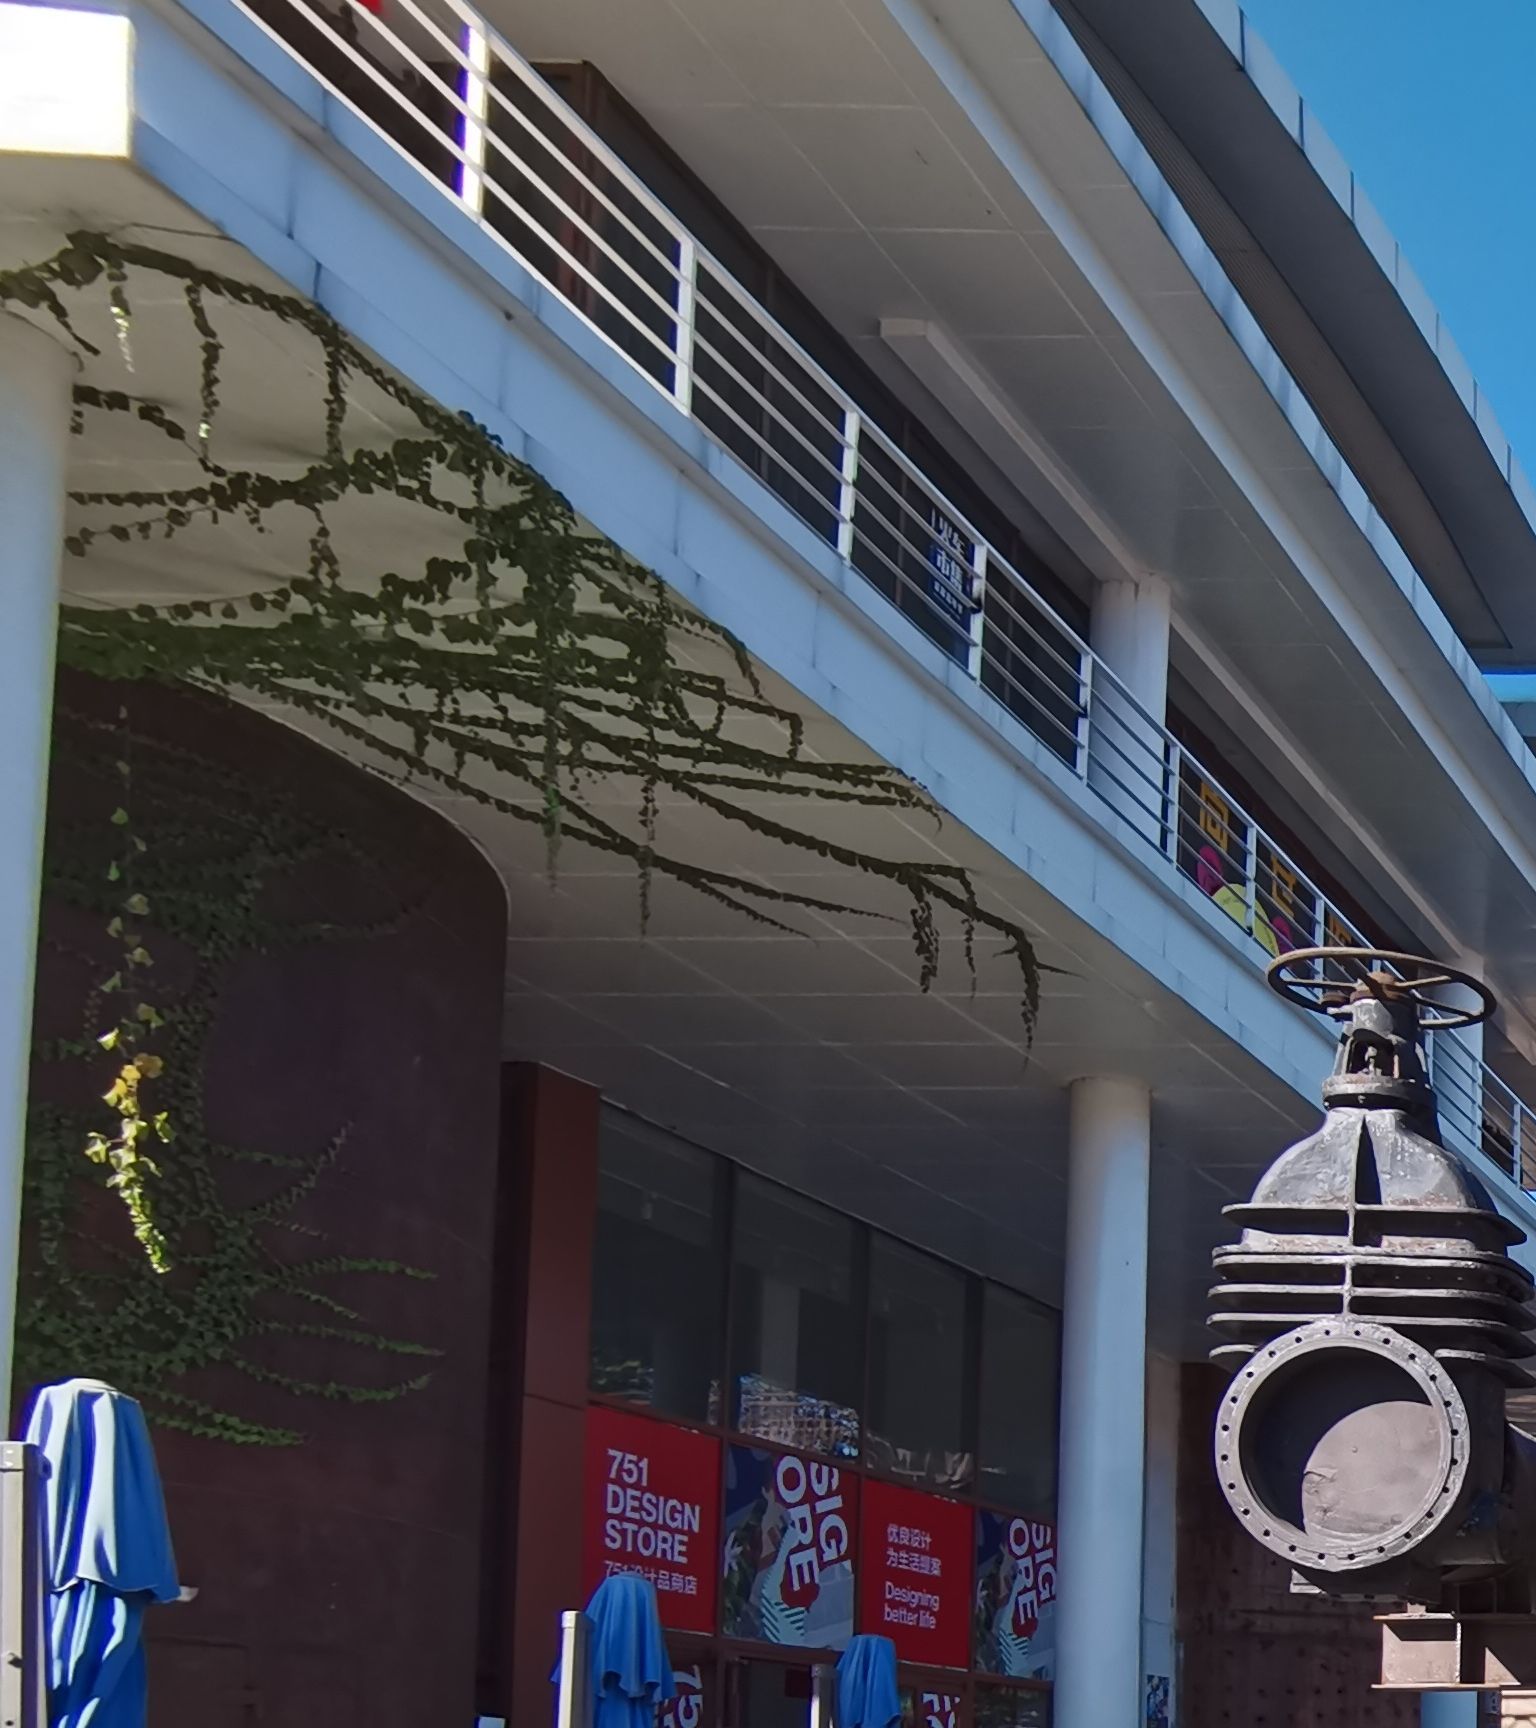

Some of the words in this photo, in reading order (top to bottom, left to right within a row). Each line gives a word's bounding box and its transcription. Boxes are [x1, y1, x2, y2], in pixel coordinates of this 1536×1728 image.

[607, 1448, 649, 1487] 751
[605, 1483, 701, 1533] DESIGN
[604, 1519, 689, 1564] STORE
[884, 1580, 940, 1611] Designing
[883, 1603, 918, 1626] better
[918, 1610, 936, 1629] life
